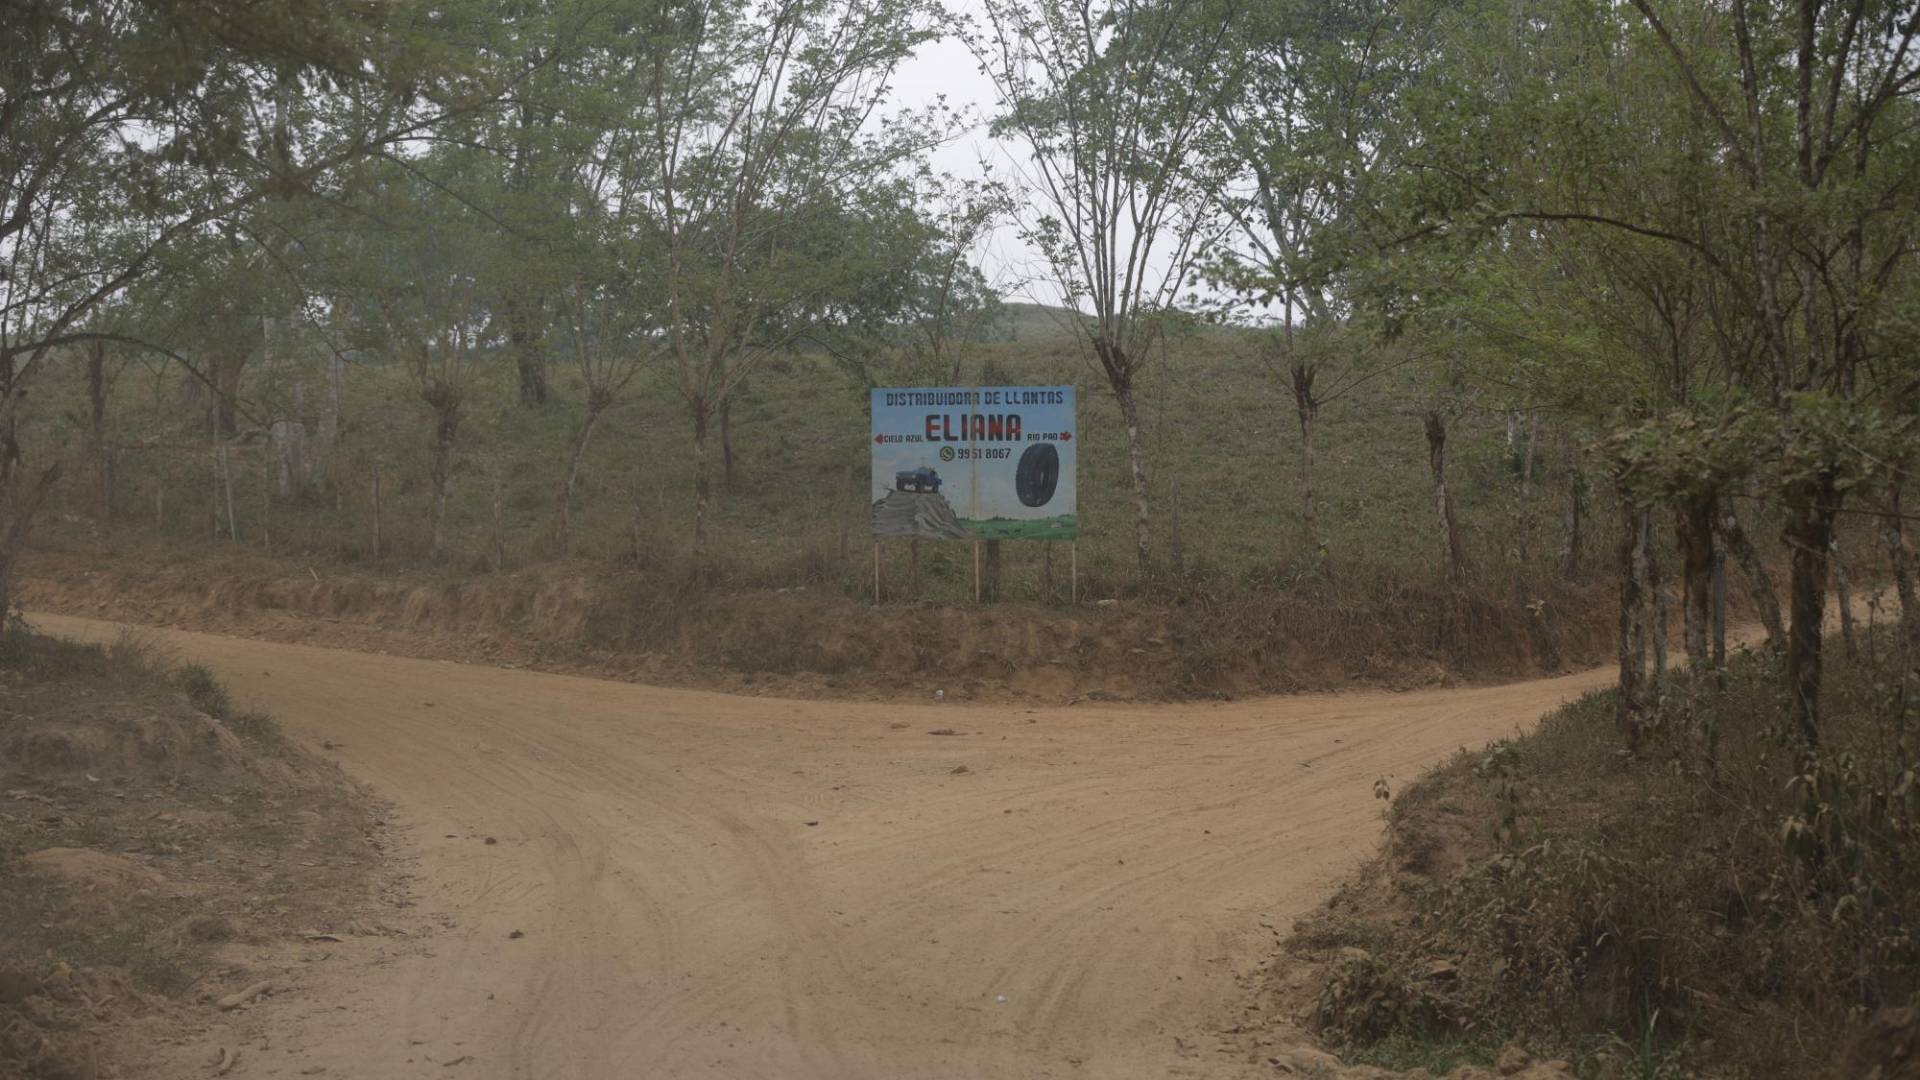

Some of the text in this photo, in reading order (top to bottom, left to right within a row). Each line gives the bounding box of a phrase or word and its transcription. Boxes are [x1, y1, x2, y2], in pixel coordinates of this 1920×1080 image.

[886, 391, 1063, 406] DISTRIBUIDORA DE LLANTAS
[926, 414, 1021, 441] ELIANA
[884, 434, 923, 443] CIELO AZUL
[985, 448, 1011, 459] 8067
